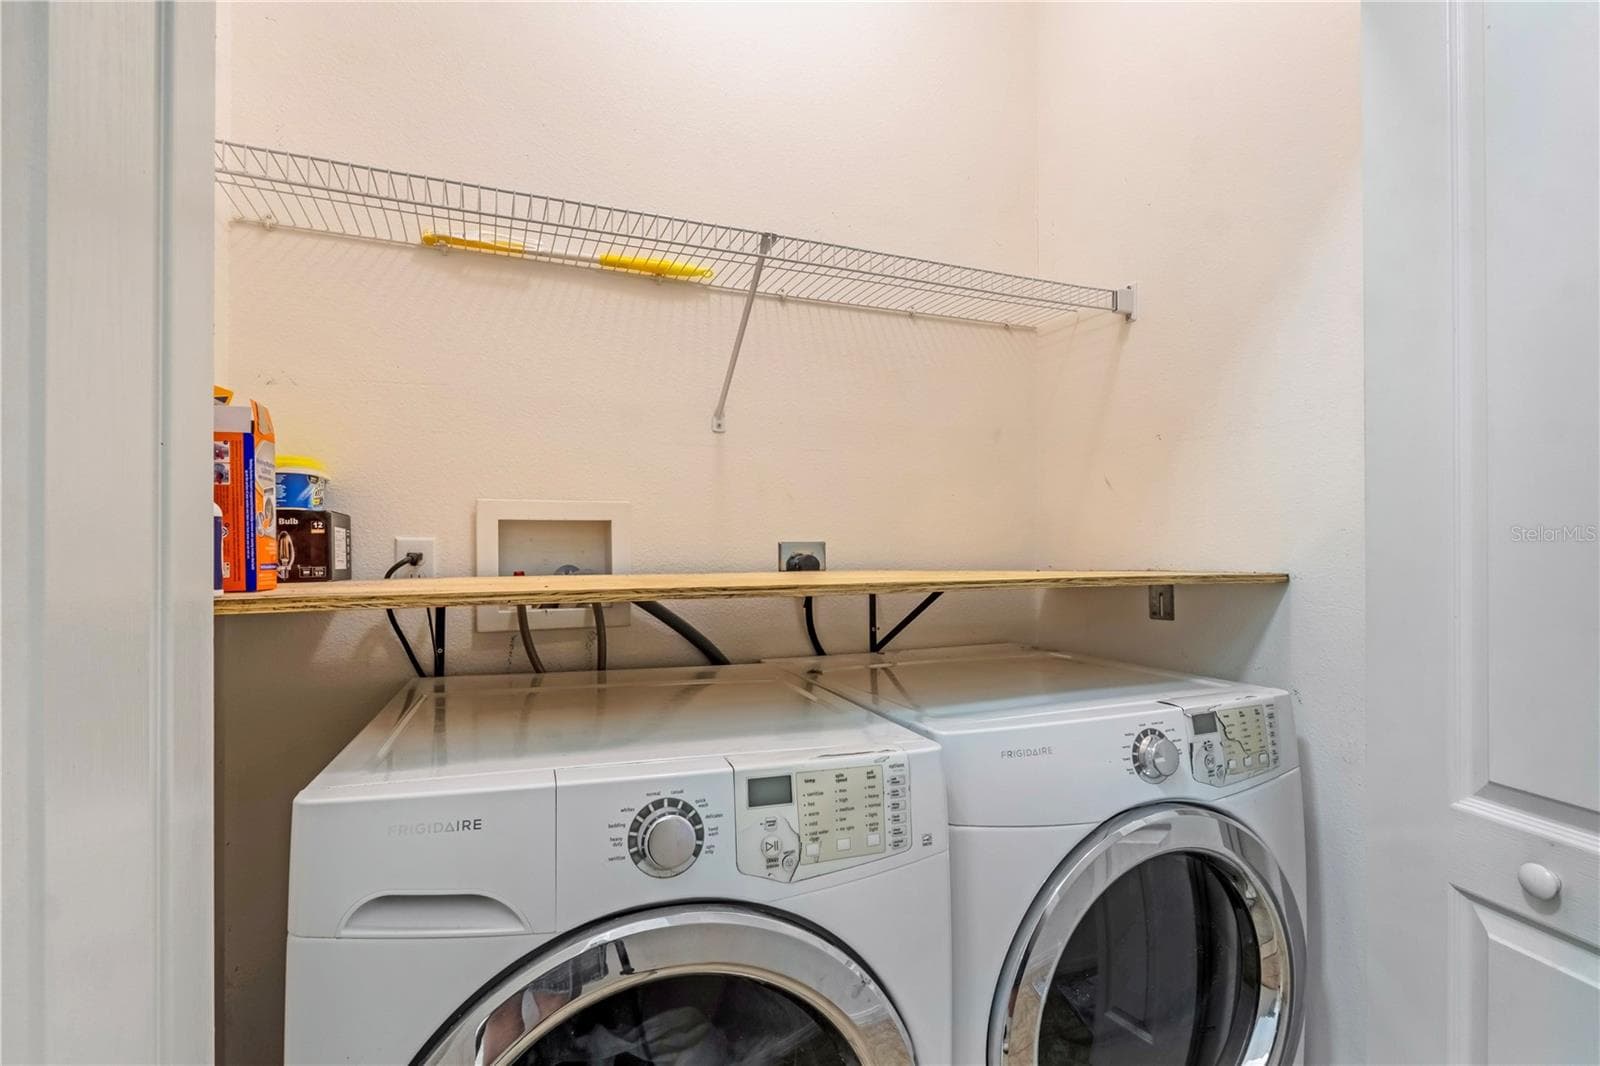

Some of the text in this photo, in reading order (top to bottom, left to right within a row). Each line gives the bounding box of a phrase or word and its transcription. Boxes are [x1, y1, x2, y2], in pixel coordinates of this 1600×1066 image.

[278, 517, 299, 525] Bulb
[312, 521, 324, 529] 12
[1000, 746, 1053, 759] FRIGIDAIRE
[387, 818, 482, 837] FRIGIDAIRE
